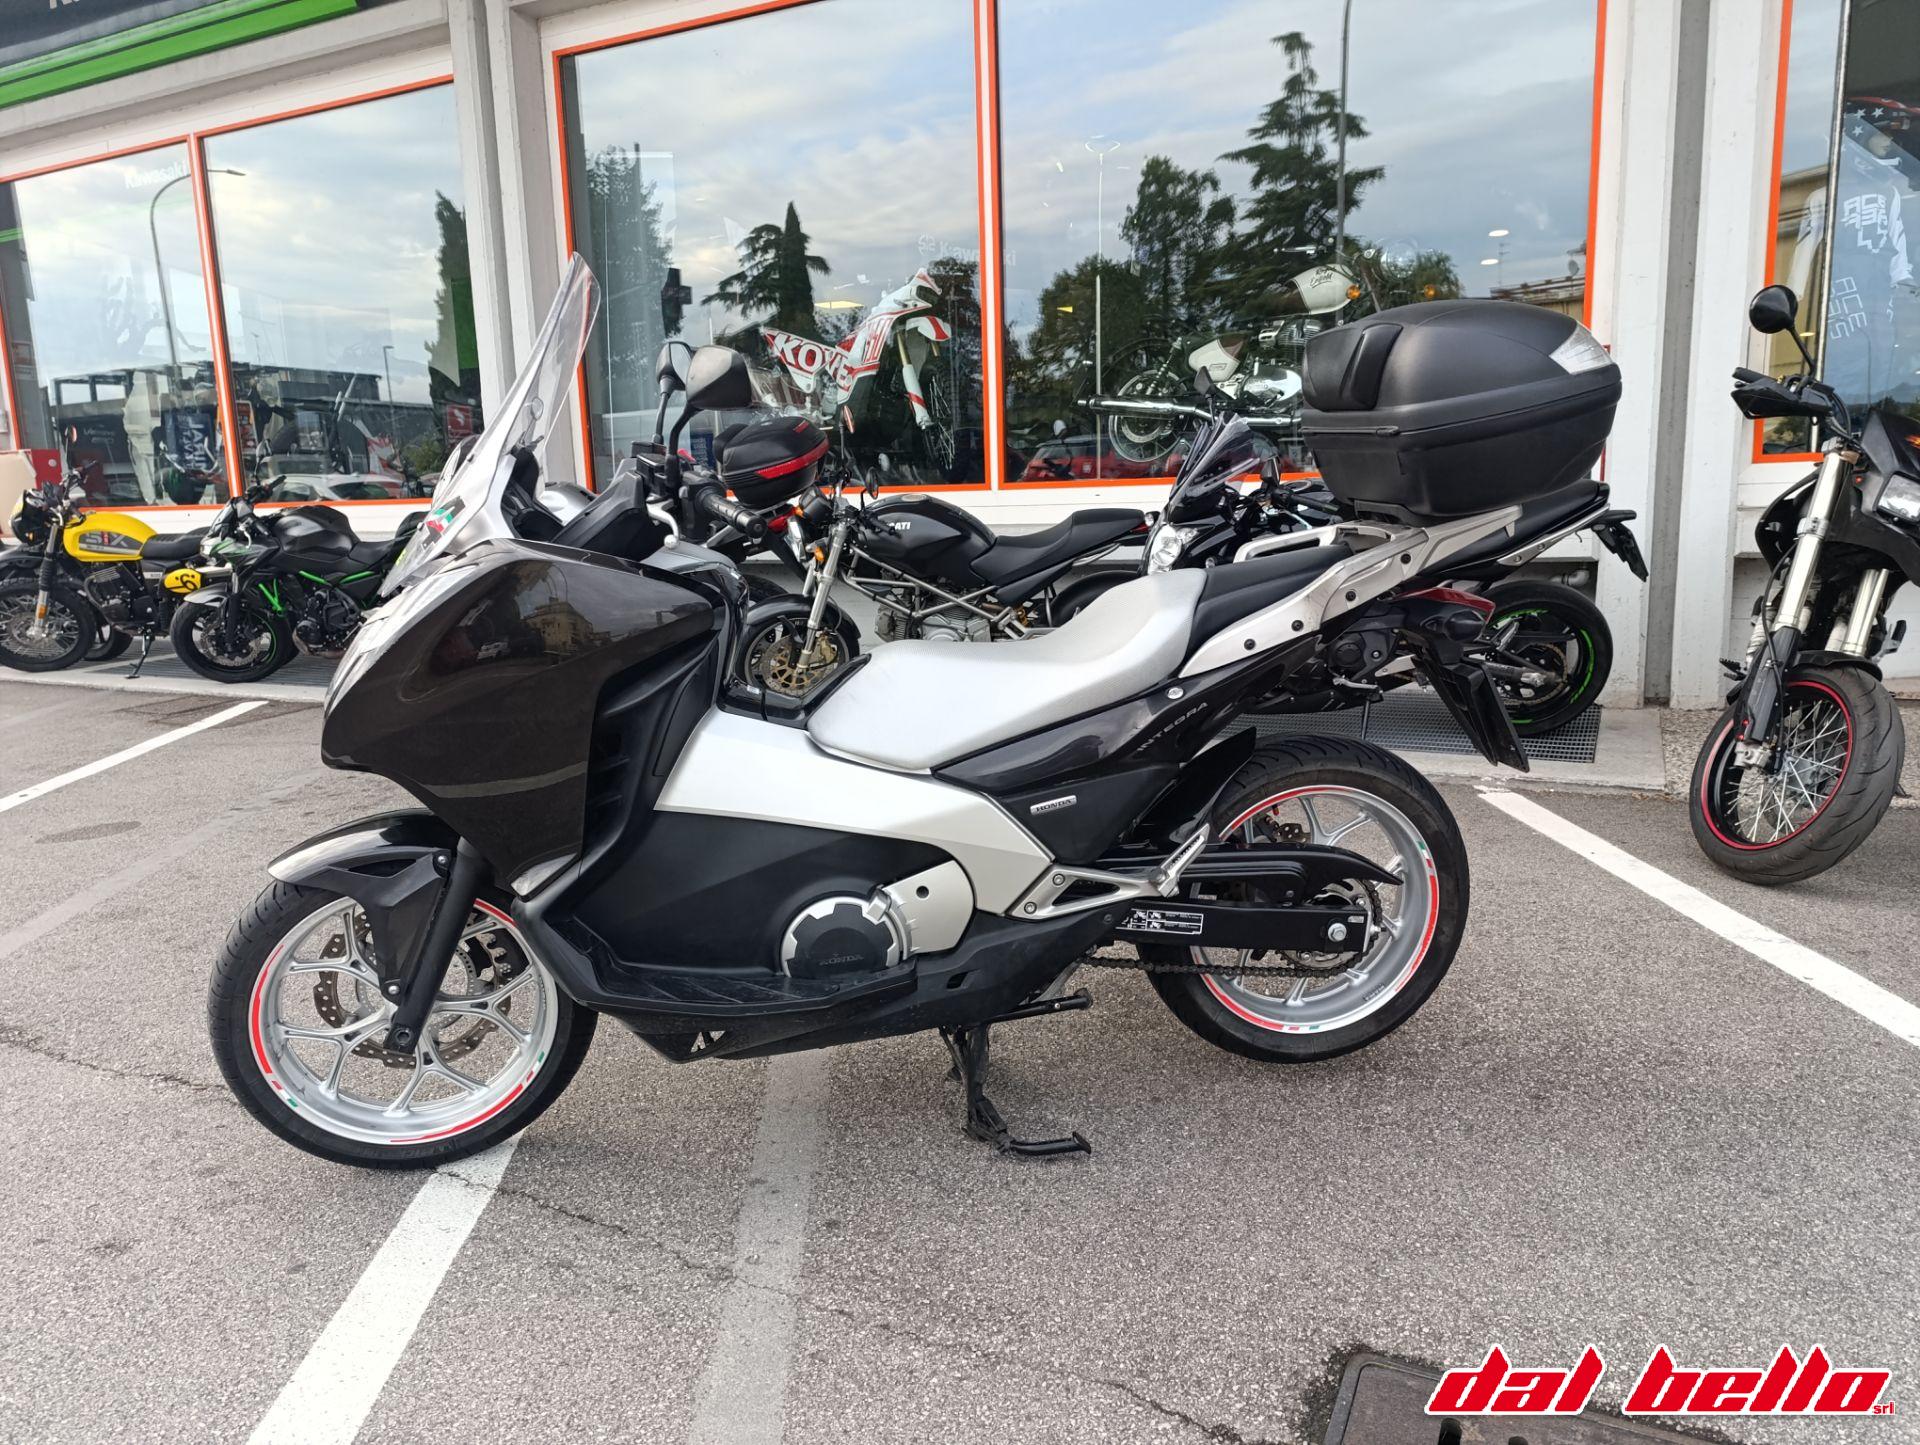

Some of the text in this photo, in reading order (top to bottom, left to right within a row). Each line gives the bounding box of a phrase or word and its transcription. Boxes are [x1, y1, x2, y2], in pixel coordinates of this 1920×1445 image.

[772, 332, 853, 392] KOVE
[1136, 701, 1209, 752] INTEGRA
[1036, 798, 1072, 812] HONDA
